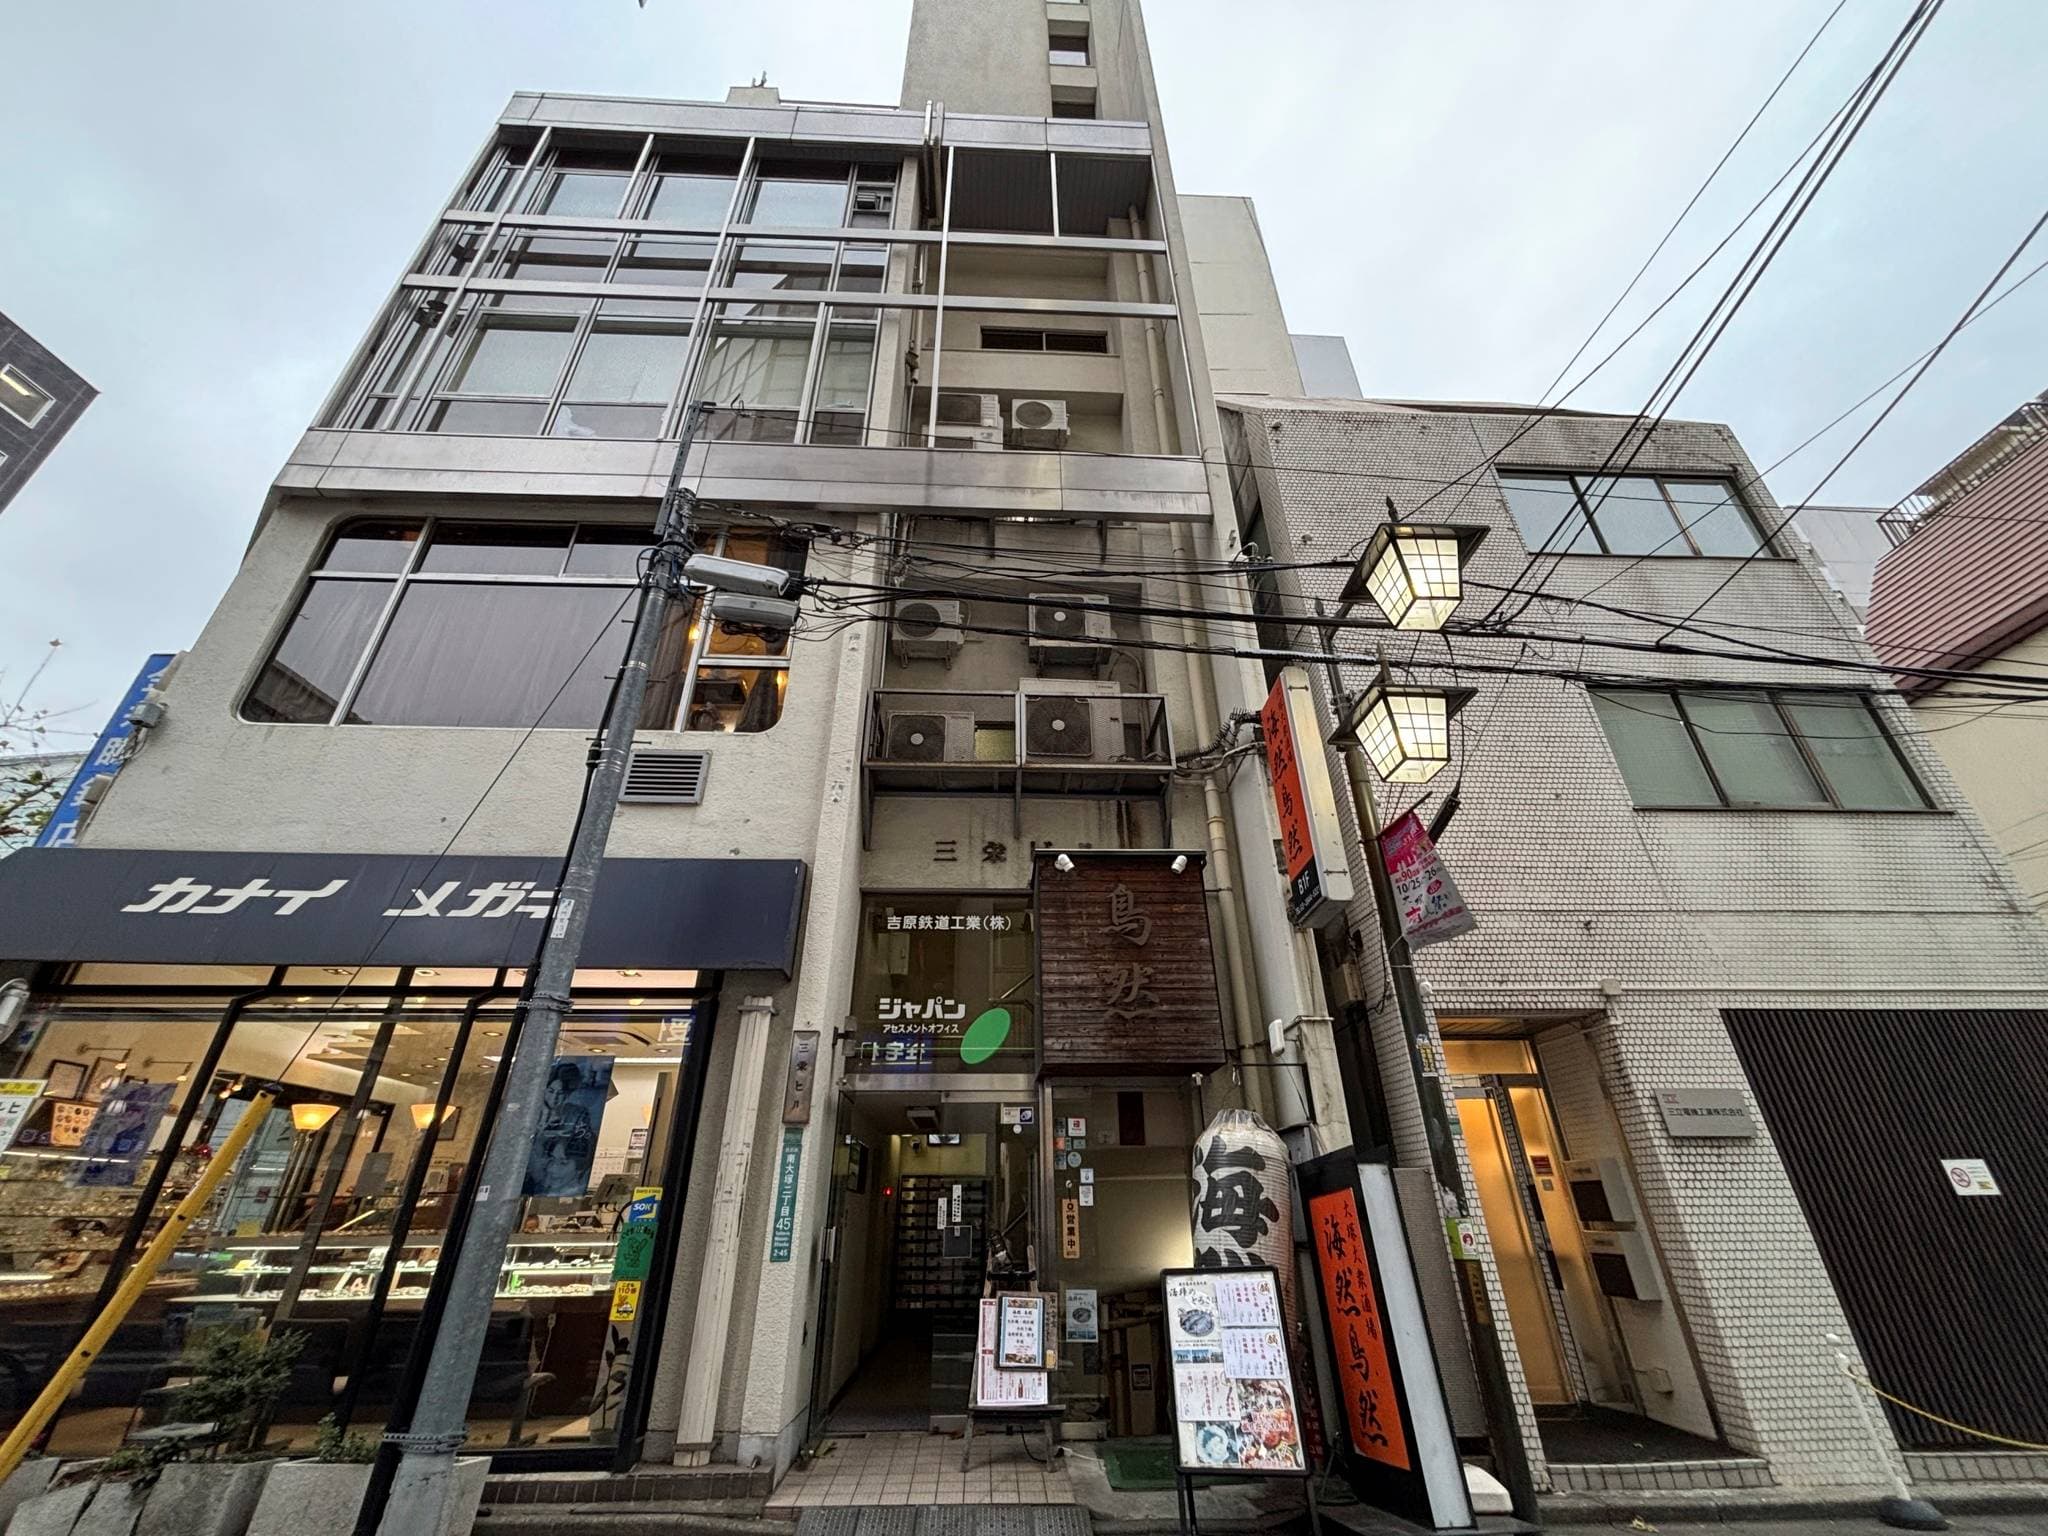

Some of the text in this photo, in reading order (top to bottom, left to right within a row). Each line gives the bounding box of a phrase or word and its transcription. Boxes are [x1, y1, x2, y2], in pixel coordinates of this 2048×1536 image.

[120, 877, 349, 915] カナイ
[878, 997, 966, 1020] ジャパン
[882, 1023, 960, 1034] アセスメントオフィス
[781, 1153, 796, 1217] 南大塚二丁目
[776, 1217, 792, 1231] 45
